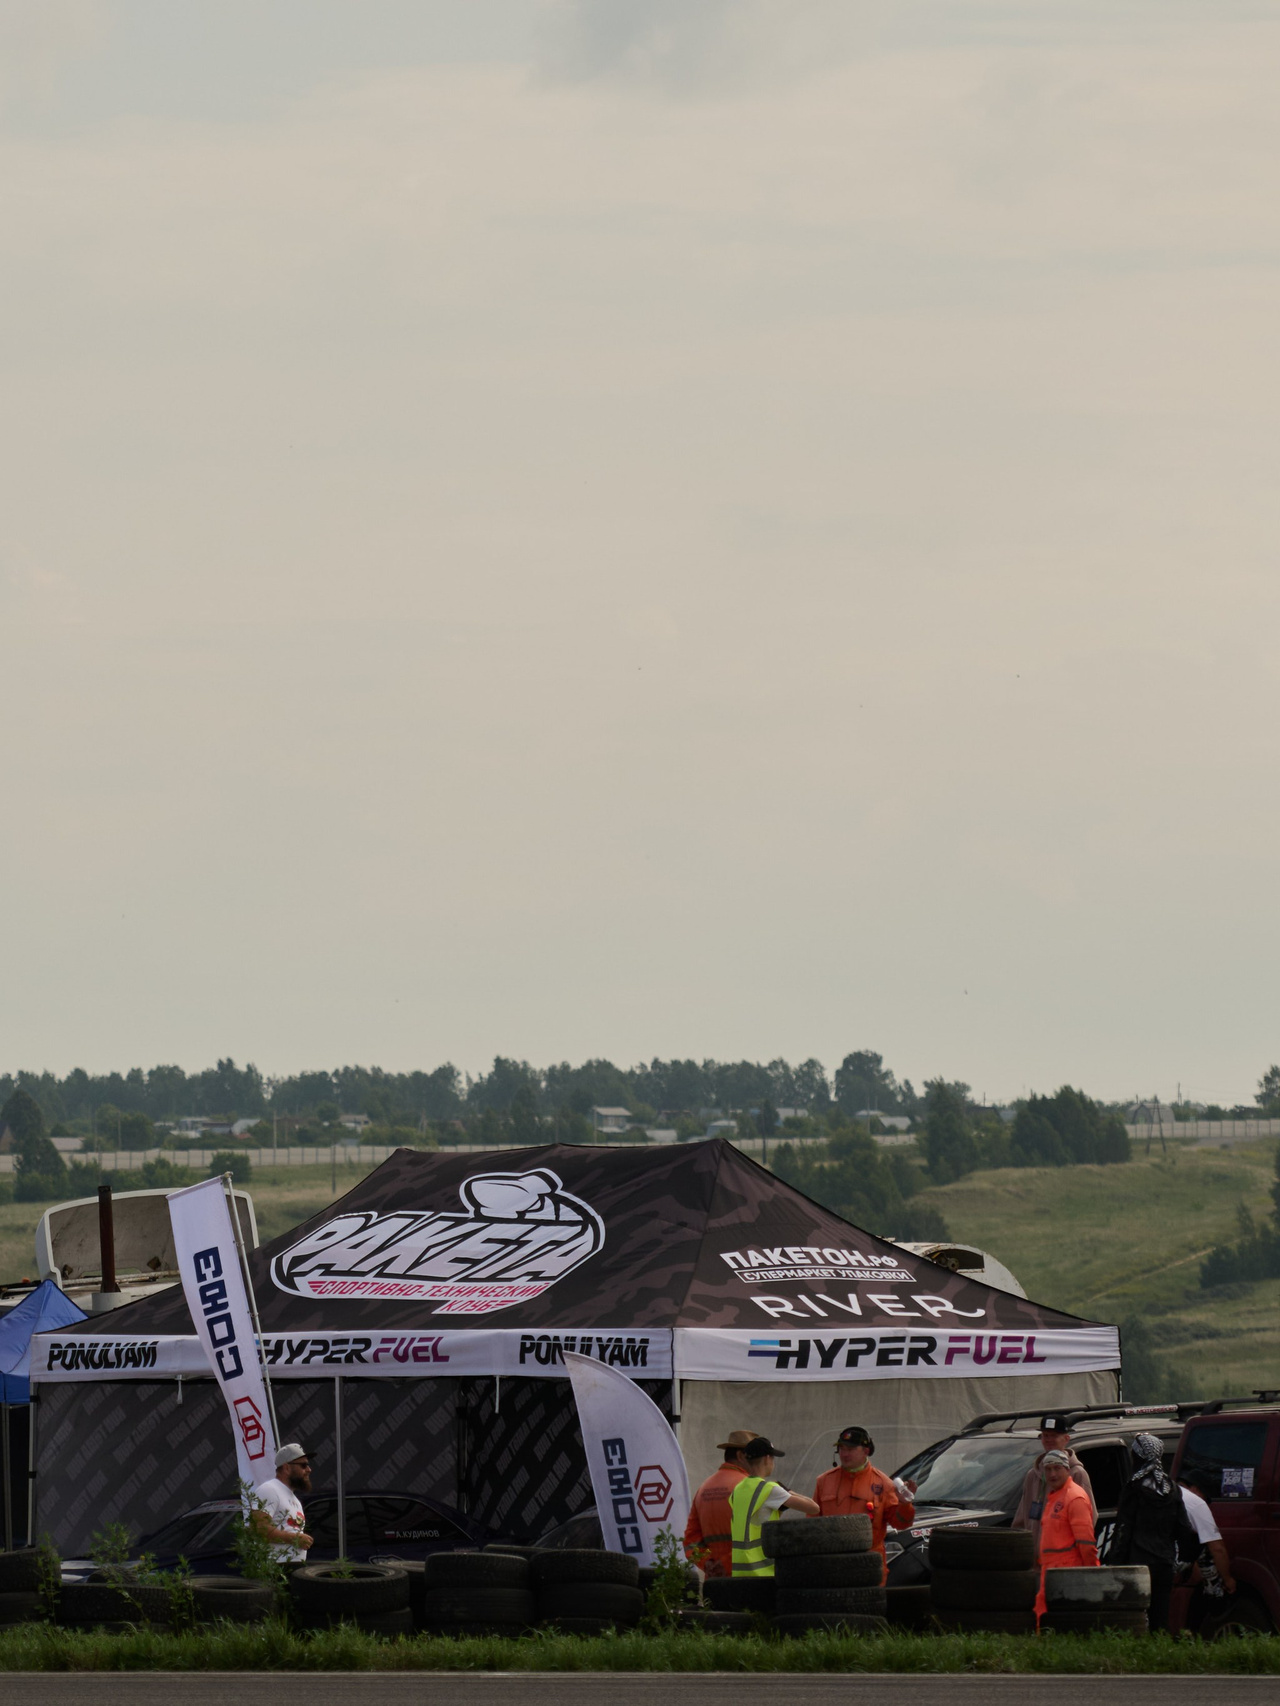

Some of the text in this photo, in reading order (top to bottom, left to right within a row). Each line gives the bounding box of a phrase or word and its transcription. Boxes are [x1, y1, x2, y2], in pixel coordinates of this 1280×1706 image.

[282, 1214, 594, 1279] РАКЕТА
[721, 1246, 899, 1269] ПАКЕТОН.РФ
[742, 1268, 909, 1281] СУПЕРМАРКЕТ УПАКОВКИ
[320, 1280, 551, 1298] СПОРТИВНО-ТЕХНИЧЕСКИЙ
[441, 1299, 494, 1312] КЛУБ
[749, 1293, 987, 1318] RIVER
[46, 1340, 160, 1372] PONULYAM
[258, 1337, 451, 1365] HYPER FUEL
[775, 1335, 1048, 1369] HYPER FUEL
[395, 1530, 441, 1540] А.КУДИНОВ
